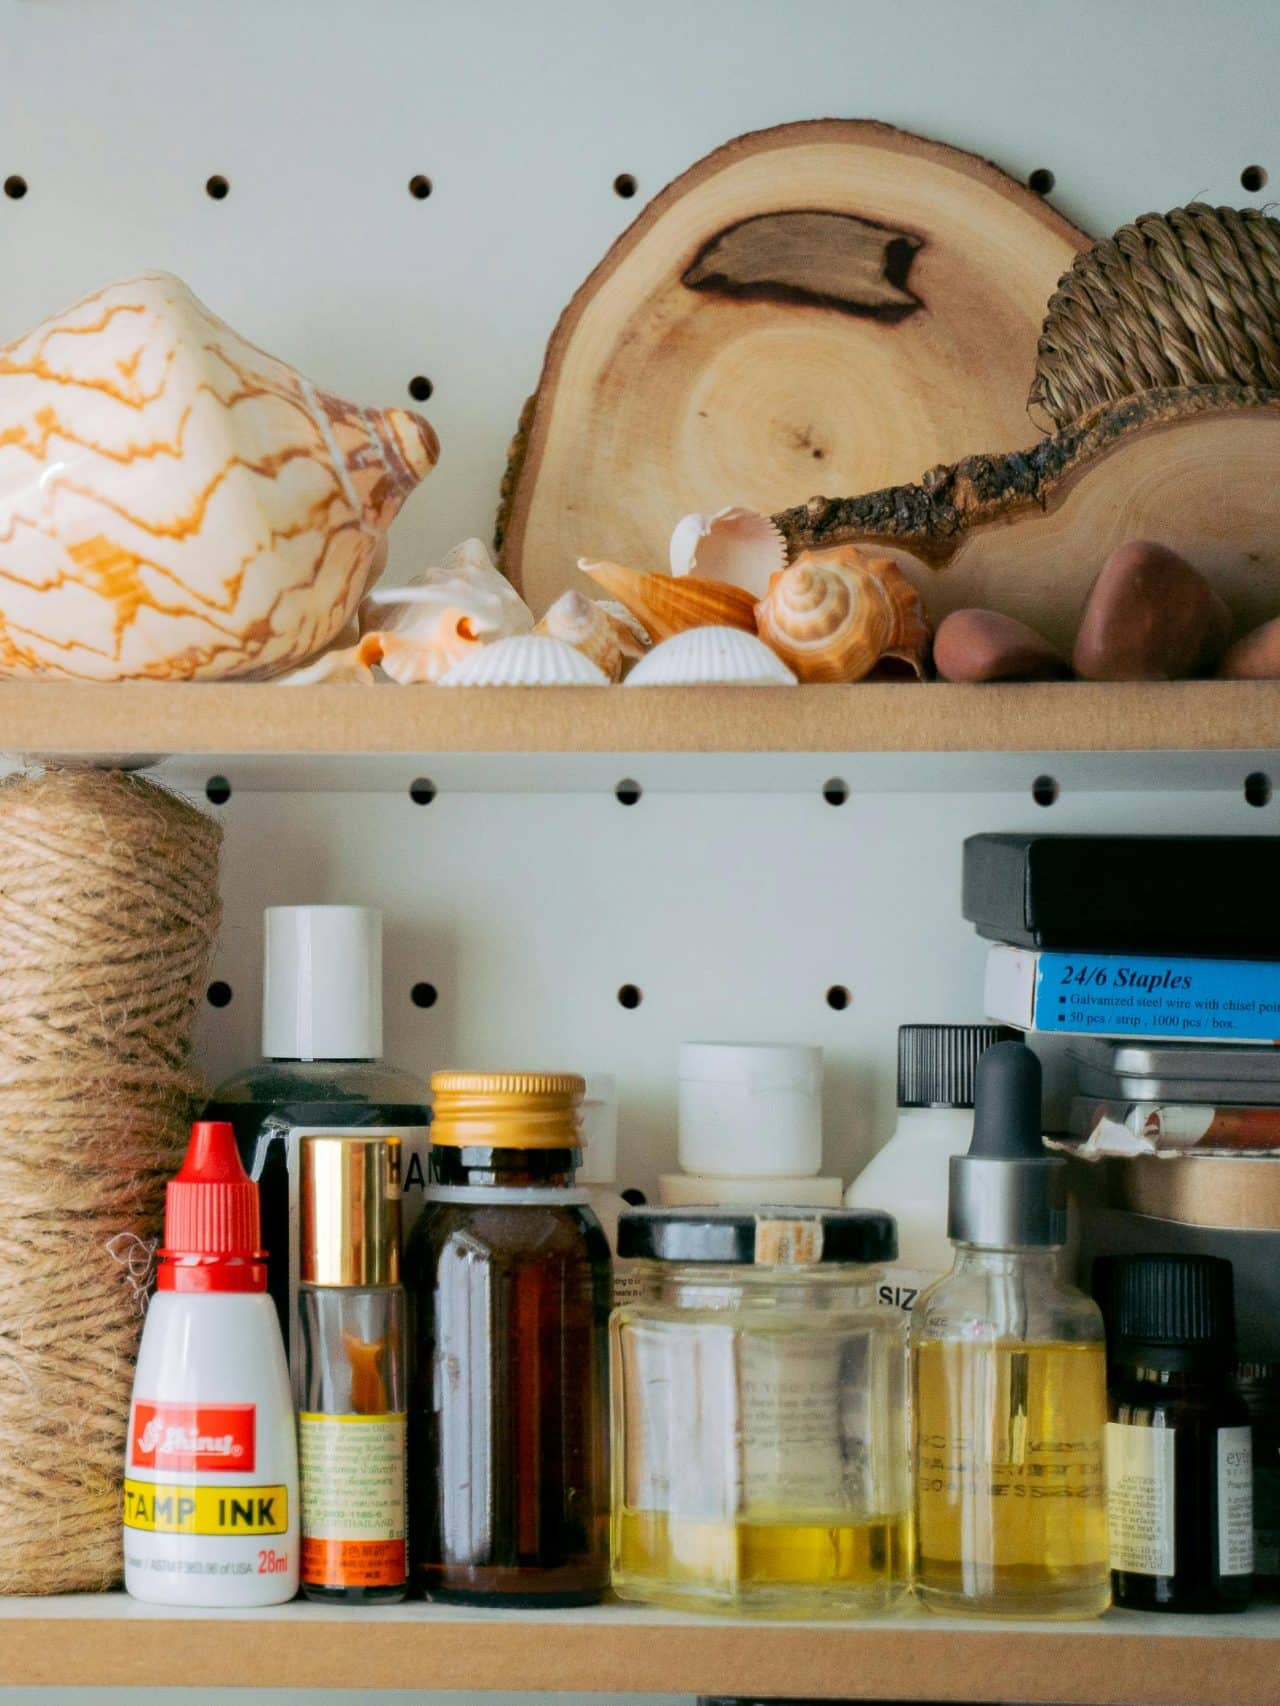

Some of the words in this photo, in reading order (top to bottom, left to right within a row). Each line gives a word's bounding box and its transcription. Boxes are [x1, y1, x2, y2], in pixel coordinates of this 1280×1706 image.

[1061, 966, 1107, 986] 24/6
[1113, 967, 1193, 993] Staples
[1070, 994, 1134, 1007] Galvanized
[1137, 996, 1163, 1008] steel
[1167, 999, 1190, 1009] wire
[1194, 999, 1219, 1011] with
[1222, 1000, 1256, 1013] chisel
[1087, 1014, 1105, 1026] pcs
[1117, 1013, 1141, 1026] strip
[1152, 1015, 1179, 1026] 1000
[1182, 1016, 1202, 1029] pcs
[878, 1285, 919, 1312] SIZ
[124, 1491, 195, 1526] TAMP
[218, 1497, 277, 1526] INK
[257, 1550, 288, 1574] 28ml
